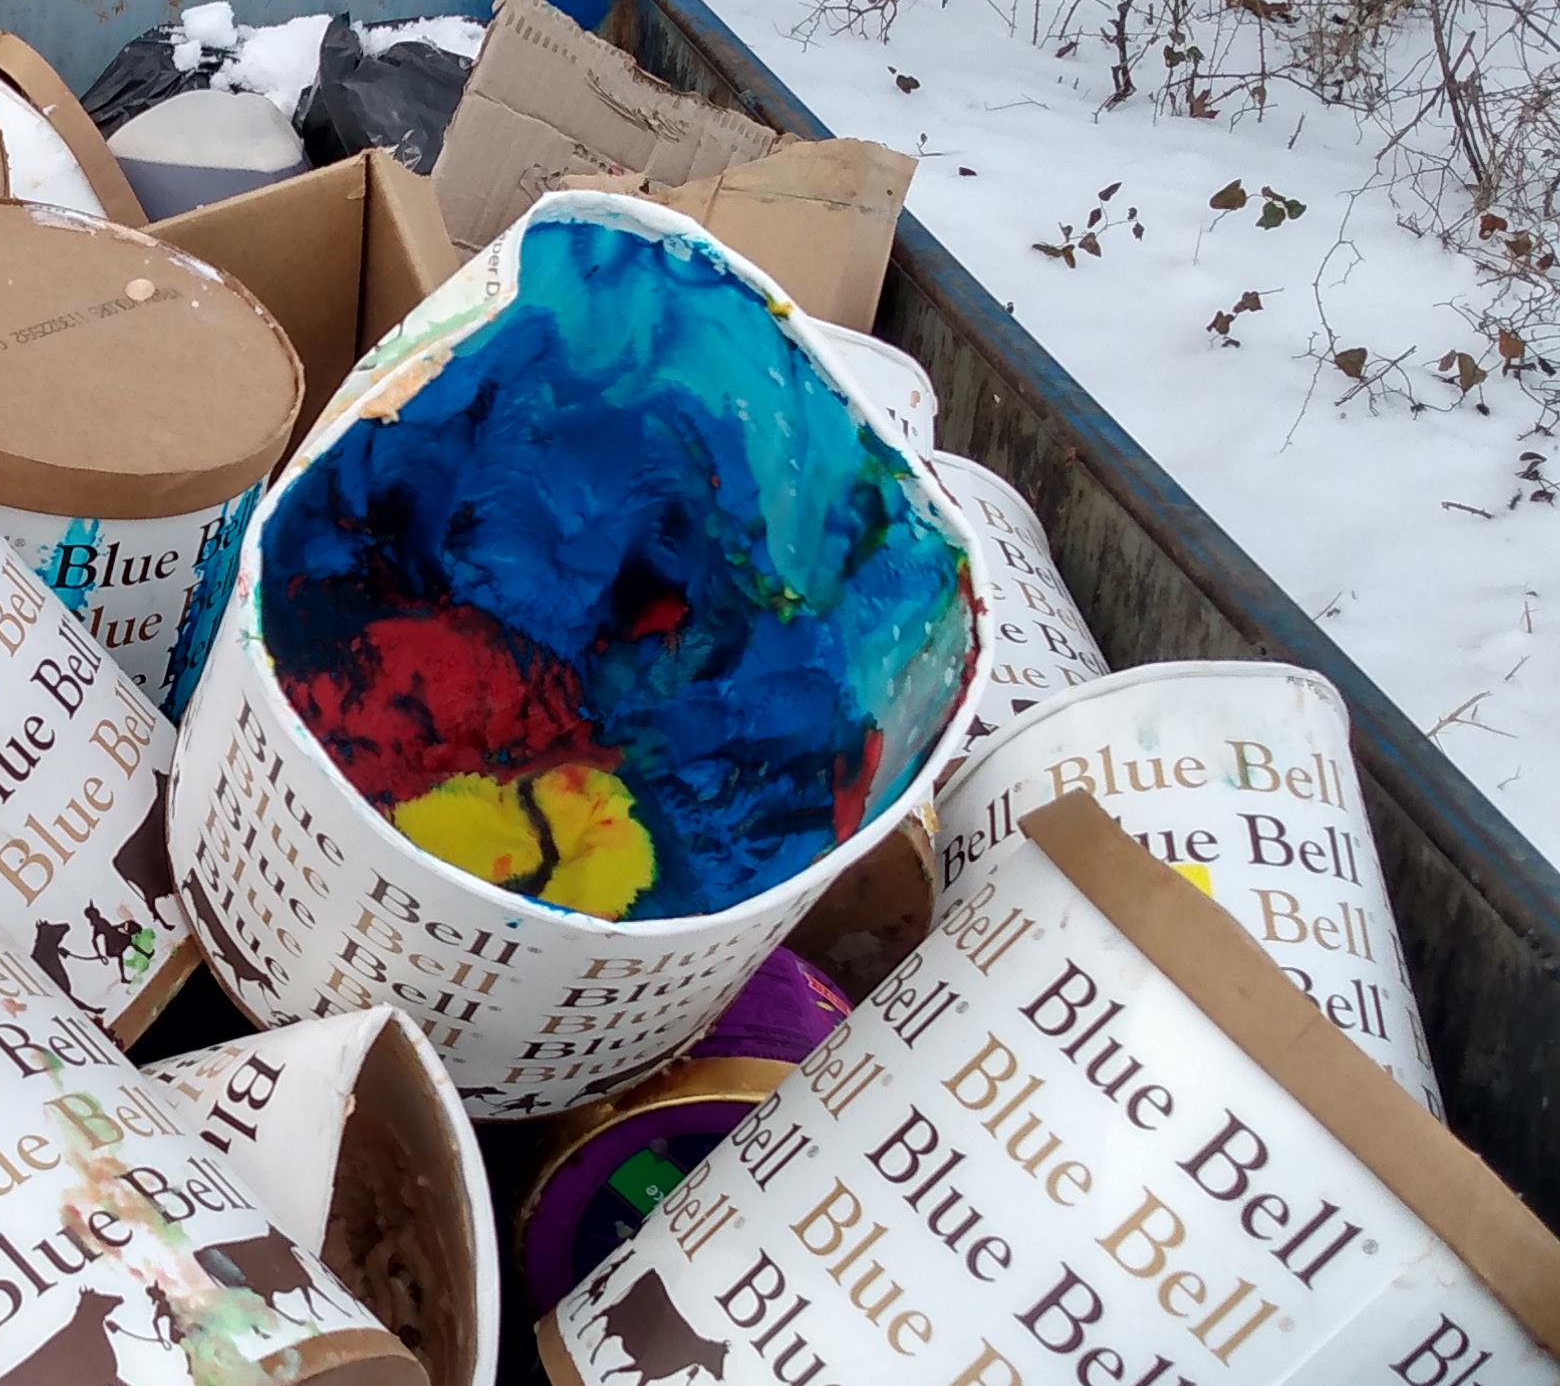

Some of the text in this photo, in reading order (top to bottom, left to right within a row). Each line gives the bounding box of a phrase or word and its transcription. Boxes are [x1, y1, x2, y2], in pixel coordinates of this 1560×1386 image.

[55, 541, 179, 590] Blue
[31, 614, 102, 716] Bell
[89, 606, 163, 649] lue
[990, 664, 1049, 689] ue
[89, 675, 158, 780] Bell
[1045, 740, 1347, 811] Blue Bell
[204, 796, 304, 958] Blue
[225, 735, 500, 997] Blue Bell
[237, 696, 521, 969] Blue Bell
[941, 787, 1016, 894] Bell
[1135, 813, 1363, 887] ue Bell
[195, 829, 291, 986] Blue
[214, 762, 482, 1023] Blue Bell
[942, 882, 1036, 977] Bell
[1250, 888, 1376, 964] Bell
[44, 1085, 186, 1151] Bell
[871, 954, 1364, 1290] Bell Blue Bell
[117, 1157, 257, 1225] Bell
[731, 1092, 811, 1192] Bell
[865, 1105, 1012, 1283] Blue
[800, 1022, 1279, 1367] Bell Blue Bell
[663, 1161, 740, 1262] Bell
[790, 1176, 933, 1357] Blue
